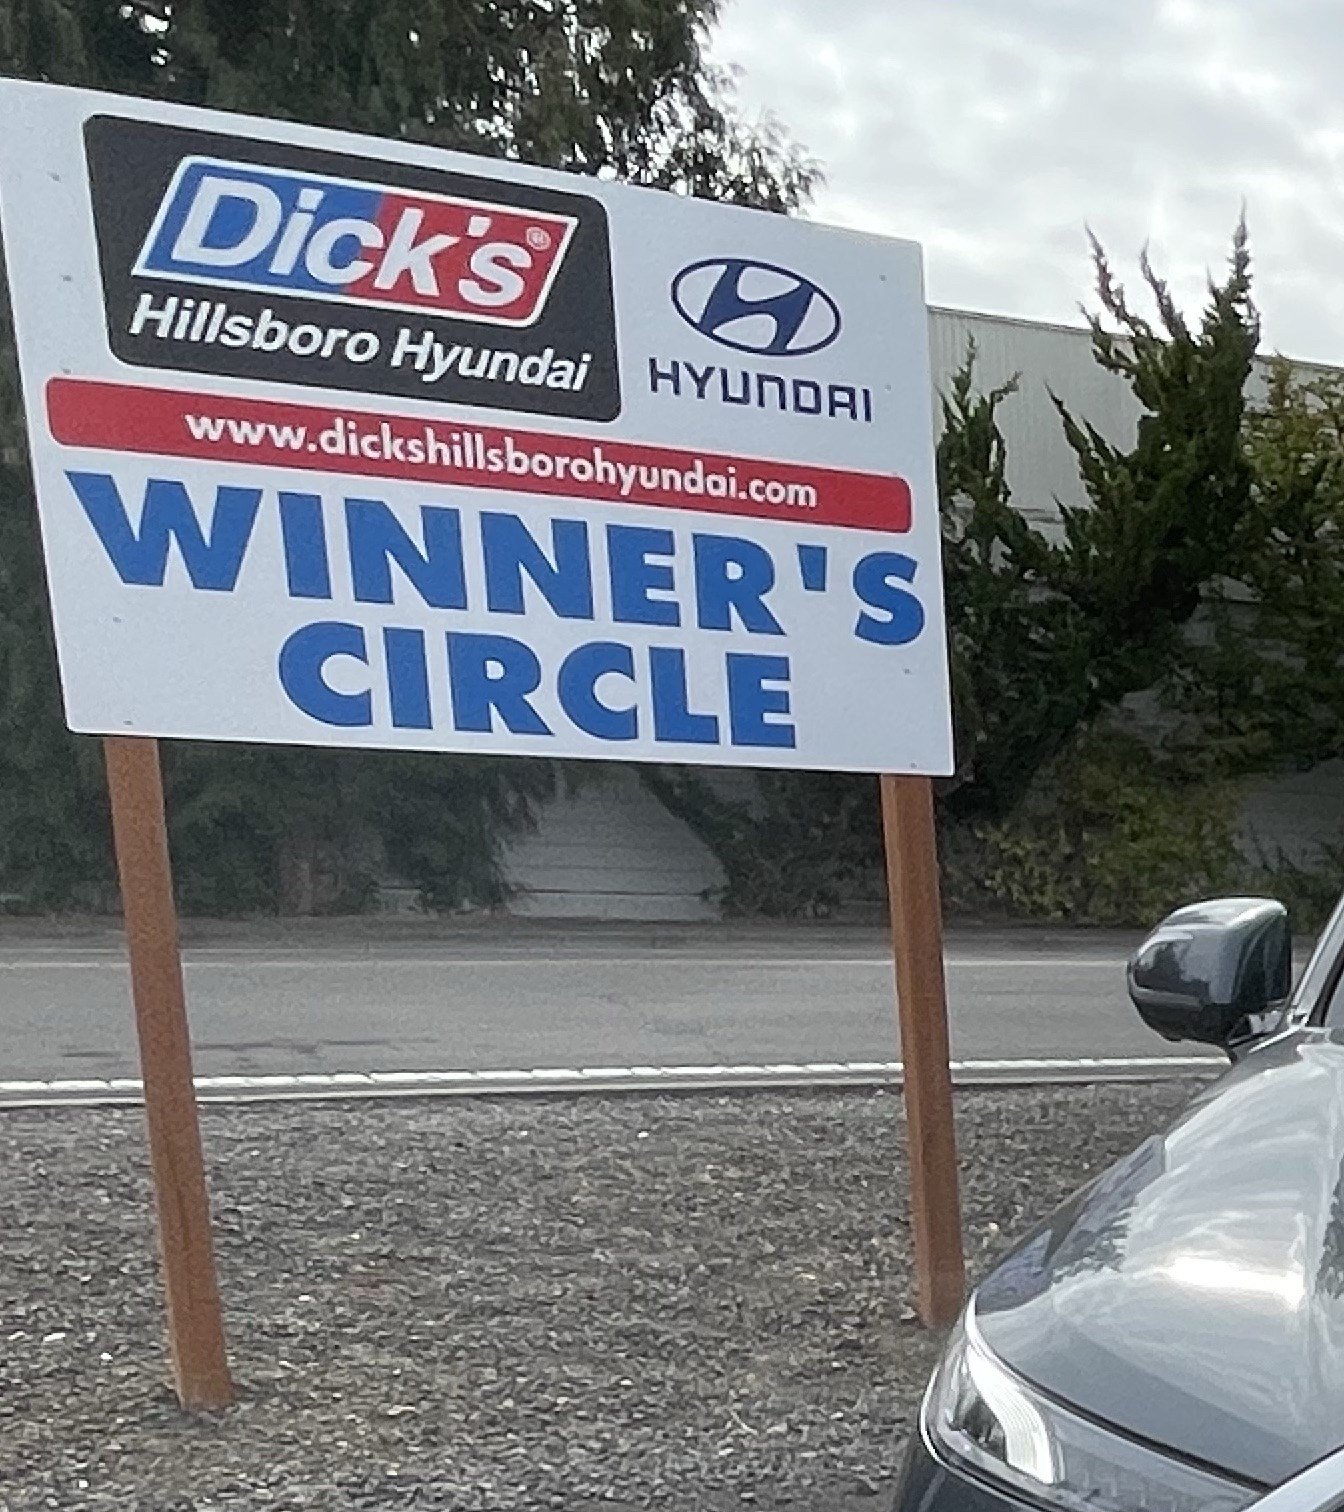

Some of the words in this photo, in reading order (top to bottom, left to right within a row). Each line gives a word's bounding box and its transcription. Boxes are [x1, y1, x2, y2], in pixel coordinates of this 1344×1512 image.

[171, 176, 533, 308] Dick's
[129, 293, 381, 361] Hillsboro
[391, 327, 592, 392] Hyundai
[649, 357, 871, 422] HYUNDAI
[186, 411, 818, 511] www.dickshillsborohyundai.com
[65, 470, 927, 646] WINNER'S
[278, 620, 797, 750] CIRCLE
